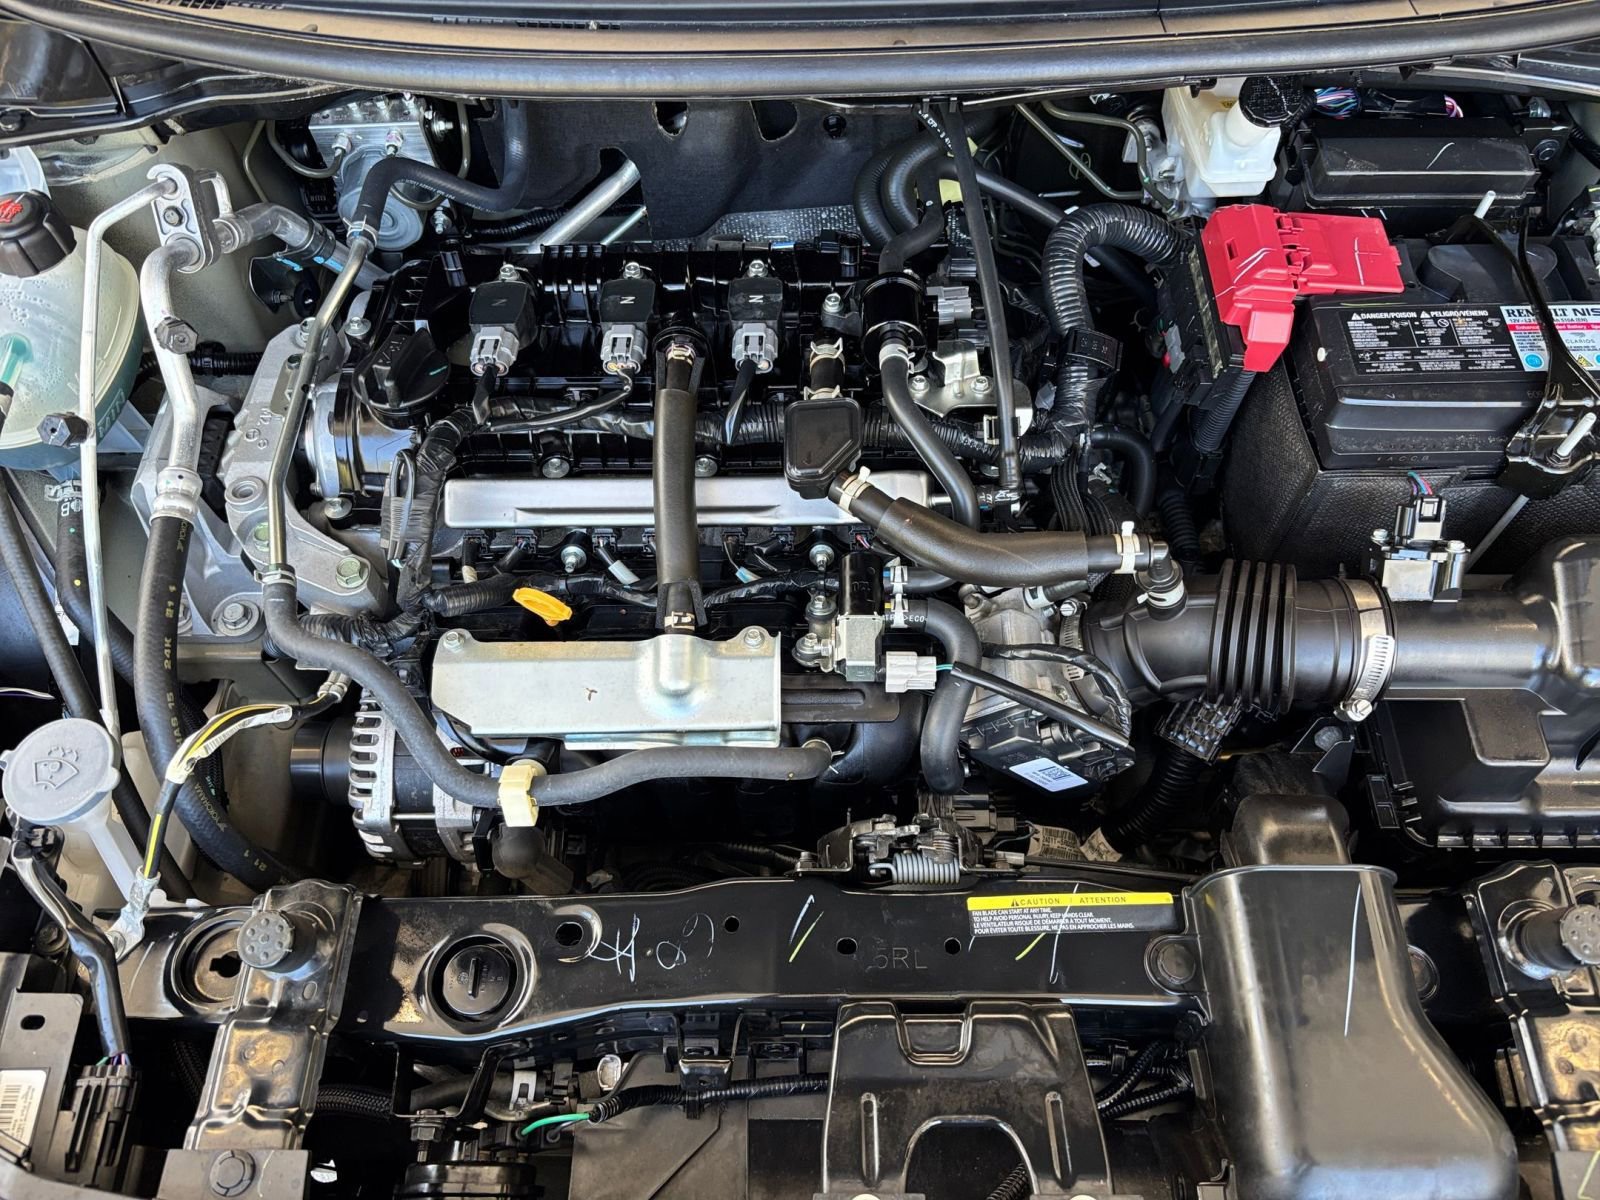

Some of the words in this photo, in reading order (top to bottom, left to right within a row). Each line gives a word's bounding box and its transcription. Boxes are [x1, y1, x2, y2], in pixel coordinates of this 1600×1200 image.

[1360, 311, 1418, 321] DANGER/POISON
[1505, 308, 1567, 317] RENLT
[163, 637, 172, 670] 24K
[195, 782, 221, 824] YOKOHAMA
[1020, 898, 1060, 906] CAUTION
[1079, 896, 1127, 904] ATTENTION
